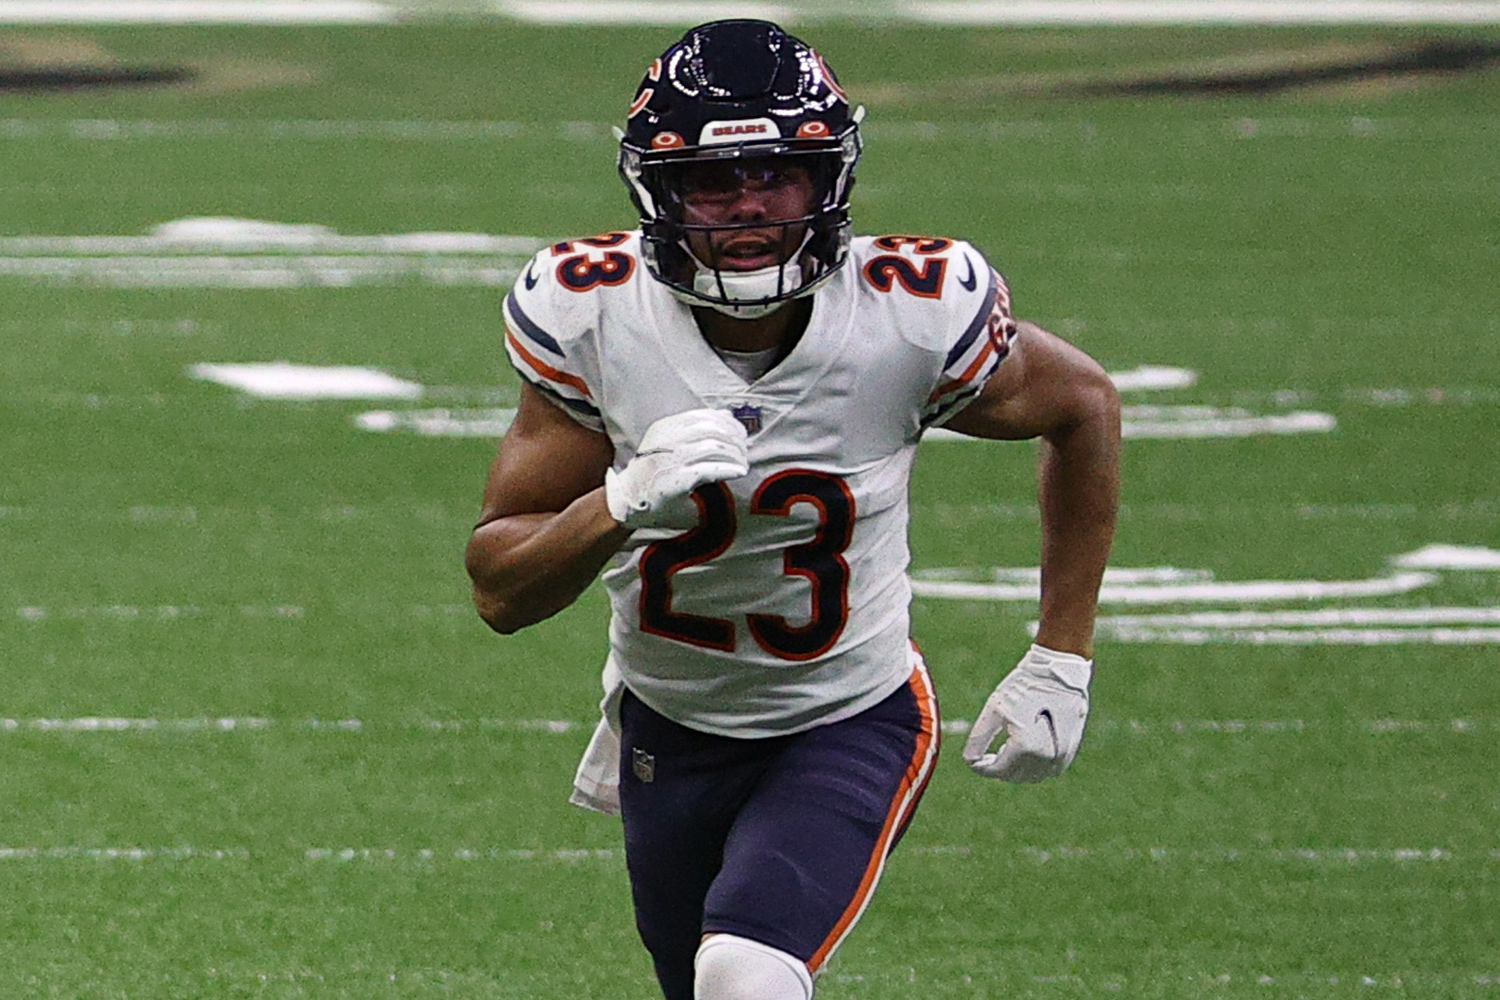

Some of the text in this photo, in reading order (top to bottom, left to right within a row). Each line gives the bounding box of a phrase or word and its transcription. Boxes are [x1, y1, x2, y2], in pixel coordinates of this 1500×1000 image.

[712, 124, 767, 136] BEARS
[863, 235, 953, 300] 23
[638, 468, 856, 662] 23
